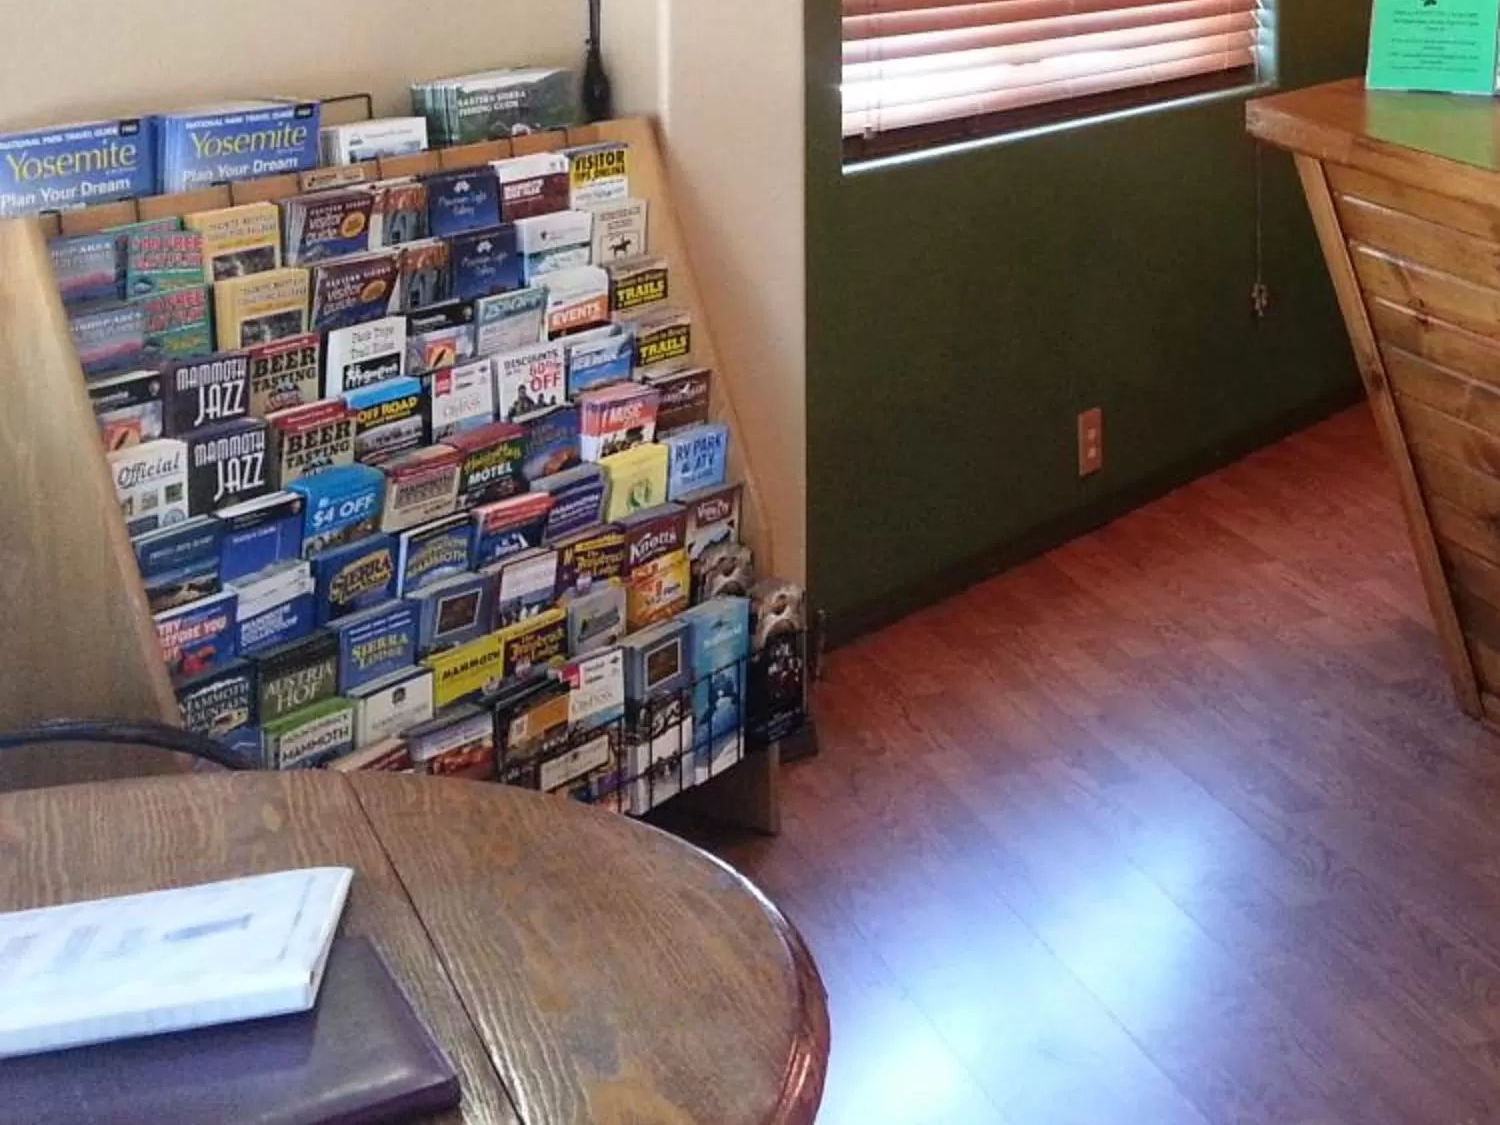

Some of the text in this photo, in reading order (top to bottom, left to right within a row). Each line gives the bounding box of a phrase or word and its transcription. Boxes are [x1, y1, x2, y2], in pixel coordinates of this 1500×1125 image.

[190, 122, 307, 159] Yosemite
[6, 138, 136, 182] Yosemite
[183, 157, 298, 189] Plan Your Dream
[575, 150, 625, 172] VISITOR
[0, 177, 131, 210] Plan Your Dream
[617, 281, 665, 301] TRAILS
[551, 302, 601, 325] EVENTS
[503, 349, 559, 370] DISCOUNTS
[639, 335, 687, 357] TRAILS
[176, 357, 246, 392] MAMMOTH
[253, 348, 317, 378] BEER
[252, 367, 317, 394] TASTING
[530, 374, 561, 392] OFF
[193, 378, 248, 427] JAZZ
[358, 407, 379, 423] OFF
[382, 396, 418, 416] ROAD
[194, 429, 265, 468] MAMMOTH
[287, 420, 352, 453] BEER
[675, 434, 722, 461] RV PARK
[286, 441, 350, 470] TASTING
[696, 454, 714, 470] ATV
[118, 452, 180, 490] Official
[213, 451, 265, 502] JAZZ
[468, 462, 513, 485] MOTEL
[313, 504, 336, 525] $4
[340, 493, 376, 517] OFF
[352, 632, 408, 659] SIERRA
[265, 659, 335, 700] AUSTRIA
[442, 651, 502, 681] MAMMOTH
[277, 684, 321, 713] HOF
[282, 726, 350, 762] MAMMOTH
